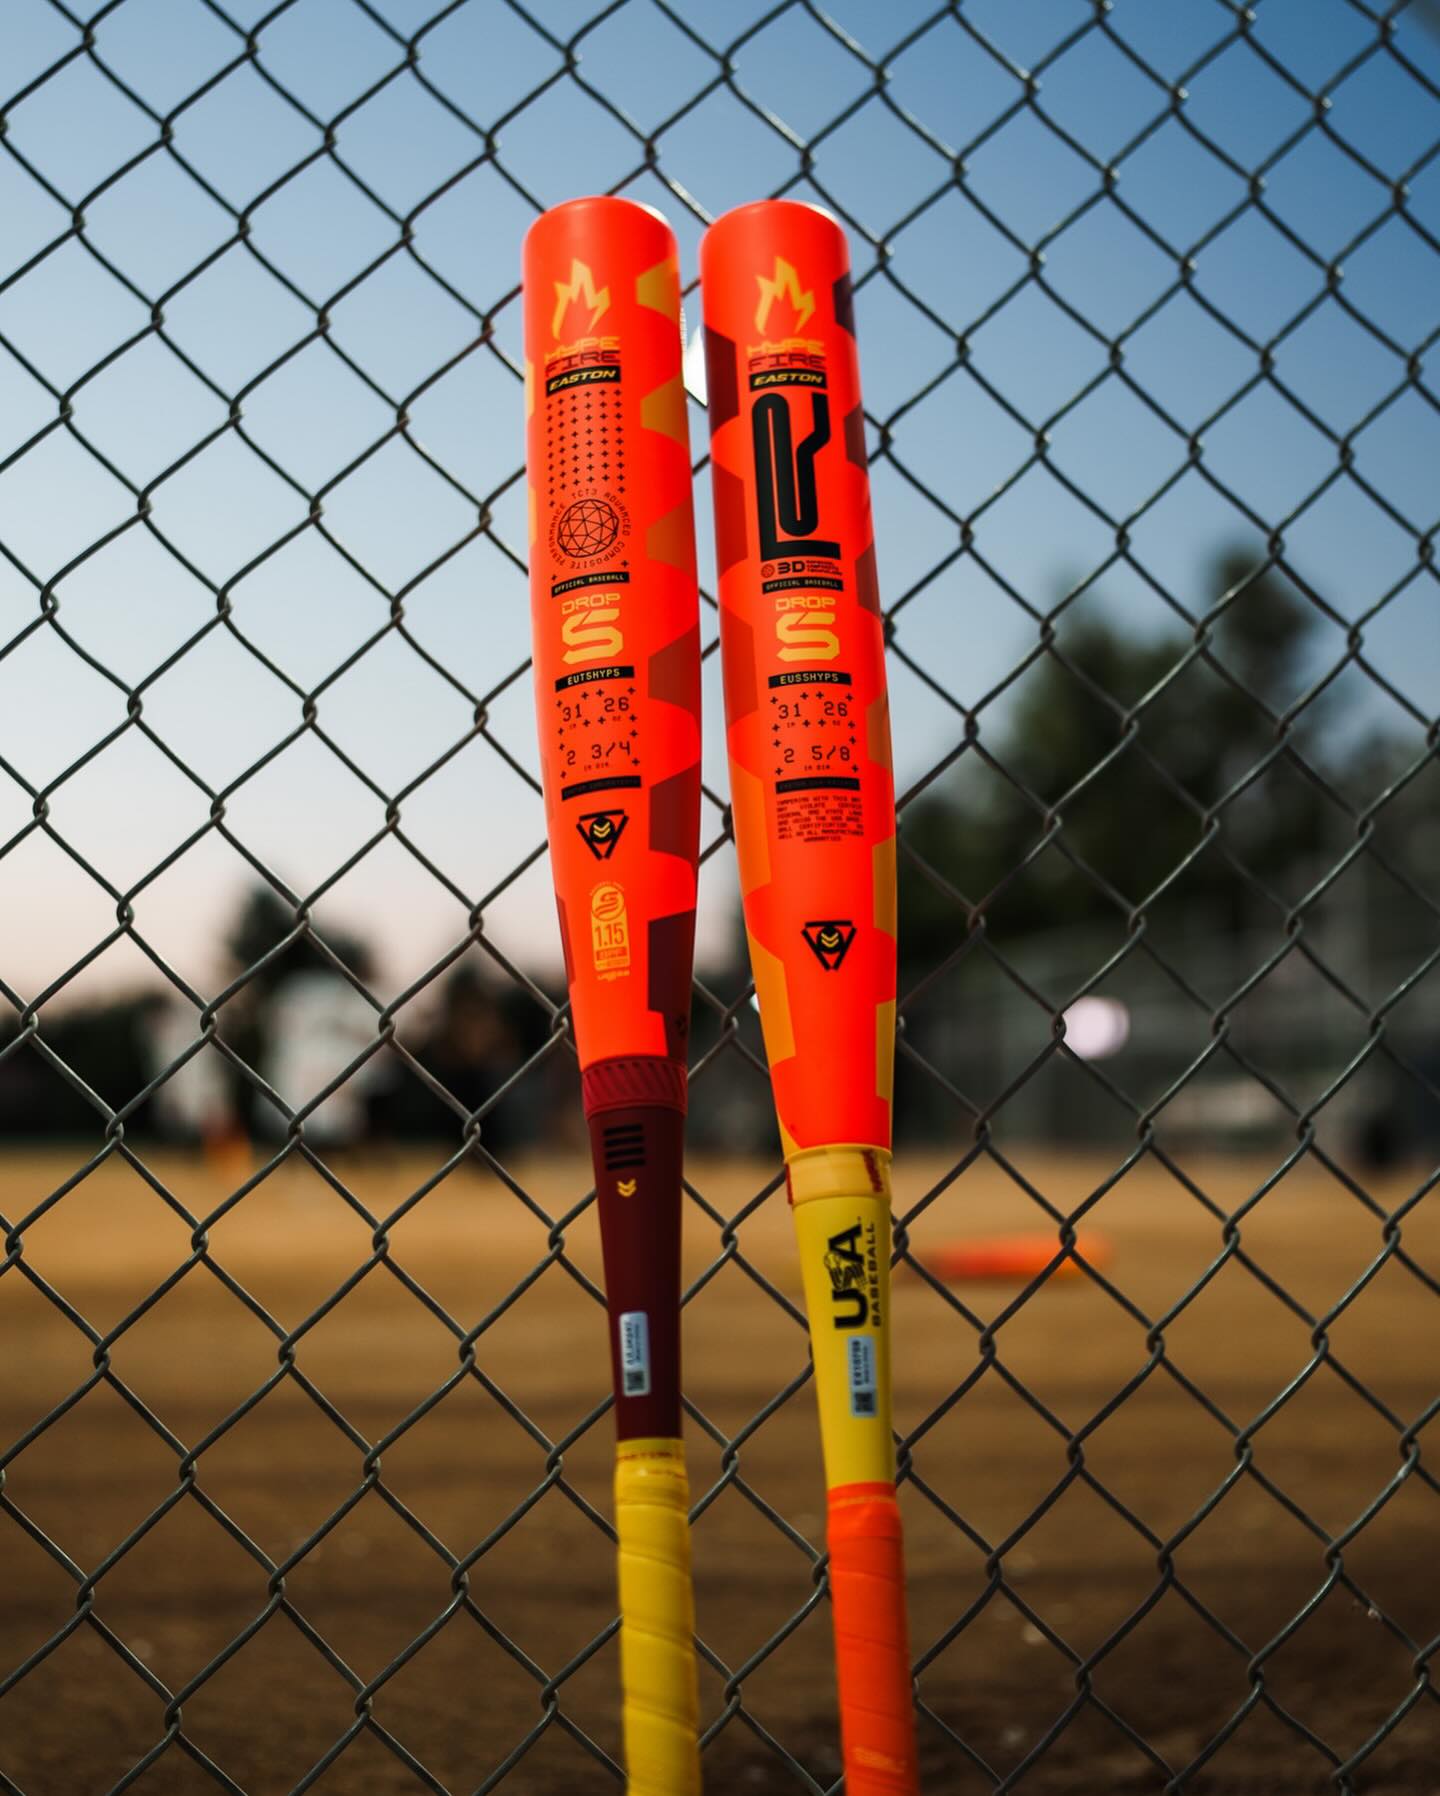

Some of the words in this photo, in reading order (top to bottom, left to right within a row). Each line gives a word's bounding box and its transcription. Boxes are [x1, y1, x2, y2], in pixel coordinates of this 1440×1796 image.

[544, 336, 620, 363] HYPE
[747, 338, 825, 358] HYPE
[545, 350, 620, 376] FIRE
[748, 353, 826, 372] FIRE
[549, 370, 616, 391] EASTON
[754, 373, 823, 386] EASTON
[570, 541, 625, 569] COMPOSITE
[778, 560, 805, 575] 3D
[554, 580, 584, 594] OFFICIAL
[589, 574, 624, 583] BASEBALL
[766, 580, 800, 591] OFFICIAL
[805, 579, 839, 588] BASEBALL
[562, 593, 620, 615] DROP
[776, 596, 836, 611] DROP
[567, 668, 620, 686] EUTSHYPS
[780, 672, 839, 685] EUSSHYPS
[563, 703, 581, 722] 31
[603, 697, 630, 712] 26
[778, 703, 801, 719] 31
[823, 701, 848, 717] 26
[567, 750, 576, 766] 2
[591, 741, 631, 760] 3/4
[783, 748, 795, 763] 2
[811, 745, 850, 761] 5/8
[594, 922, 625, 948] 1.15
[866, 1222, 882, 1328] BASEBALL
